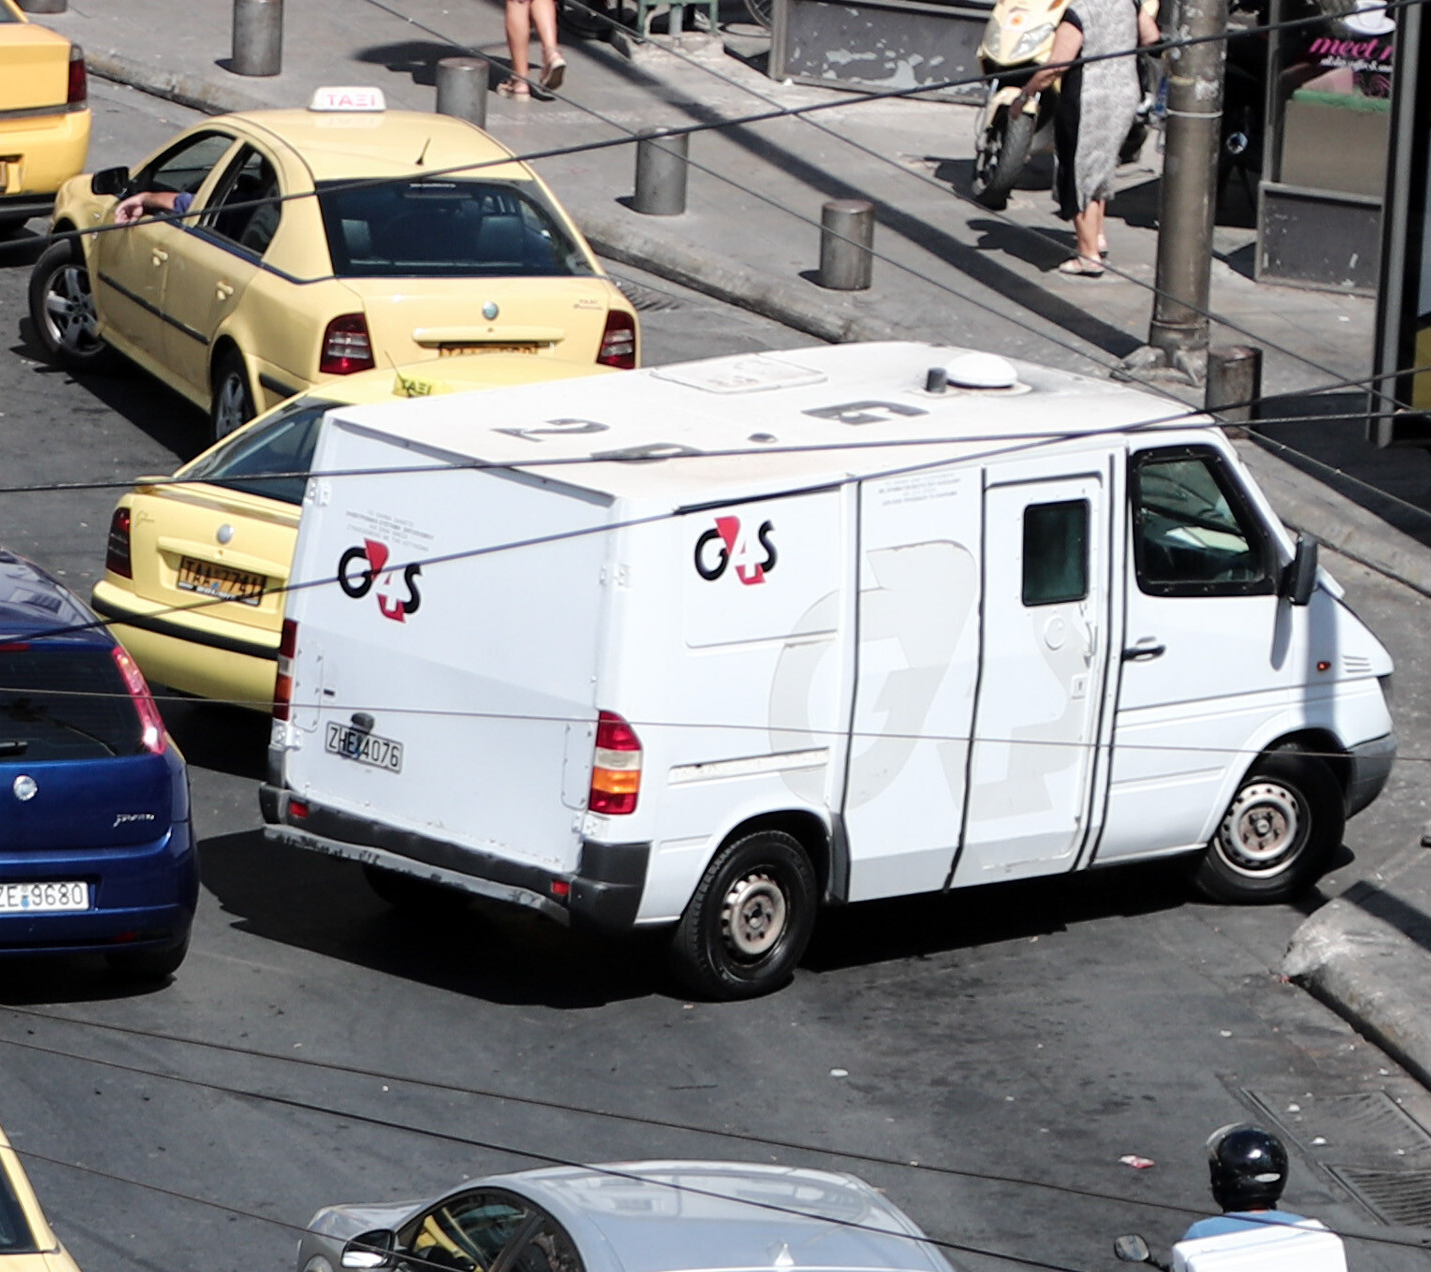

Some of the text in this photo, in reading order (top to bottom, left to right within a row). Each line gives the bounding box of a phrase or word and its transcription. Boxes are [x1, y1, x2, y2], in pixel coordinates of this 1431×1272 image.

[1309, 37, 1378, 59] meet
[326, 93, 376, 107] ΤΑΞΙ
[694, 514, 778, 586] G4S
[338, 537, 422, 624] G4S
